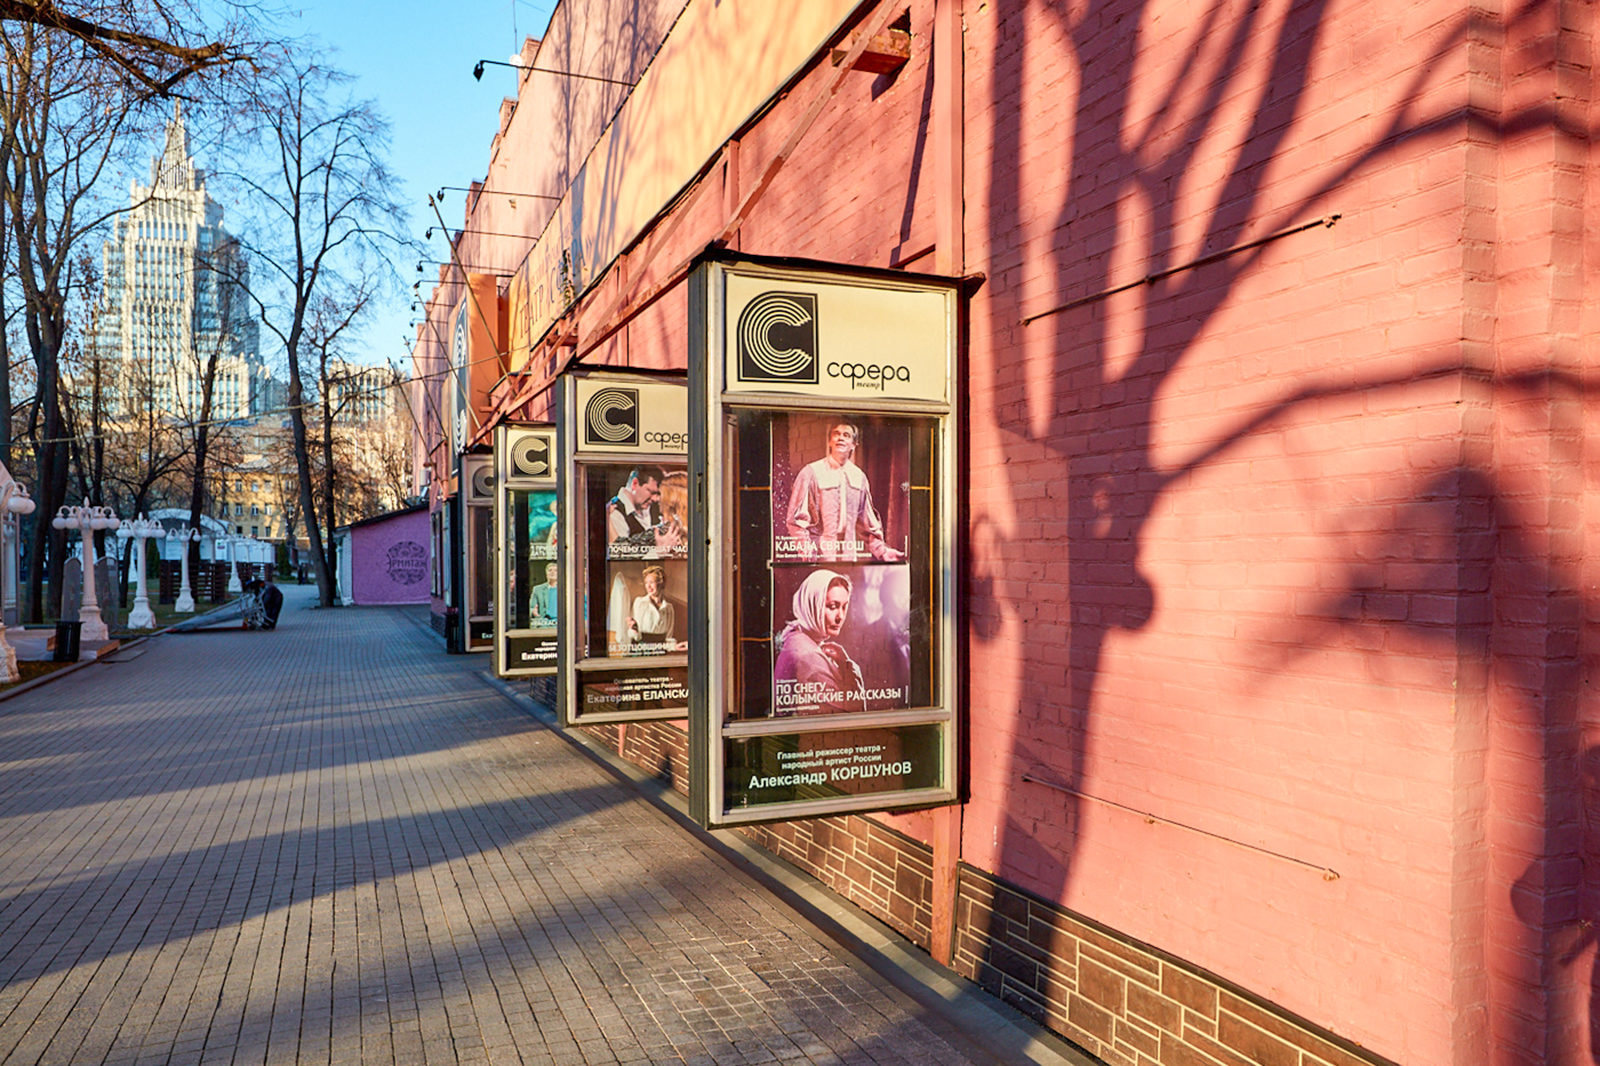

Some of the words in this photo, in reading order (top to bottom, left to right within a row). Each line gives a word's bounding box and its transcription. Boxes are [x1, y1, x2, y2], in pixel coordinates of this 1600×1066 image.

[827, 361, 911, 391] сфера
[775, 540, 818, 552] КАБАЛА
[820, 540, 865, 552] СВЯТОШ
[776, 684, 792, 695] ПО
[793, 681, 835, 694] СНЕГУ...
[587, 692, 641, 704] Екатерина
[776, 691, 844, 706] КОЛЫМСКИЕ
[846, 687, 902, 702] РАССКАЗЫ
[777, 749, 813, 760] Главный
[815, 747, 854, 759] режиссер
[855, 744, 881, 756] театра
[782, 757, 824, 770] народный
[825, 755, 852, 767] артист
[853, 753, 882, 764] России
[749, 771, 827, 789] Александр
[831, 761, 912, 782] КОРШУНОВ
